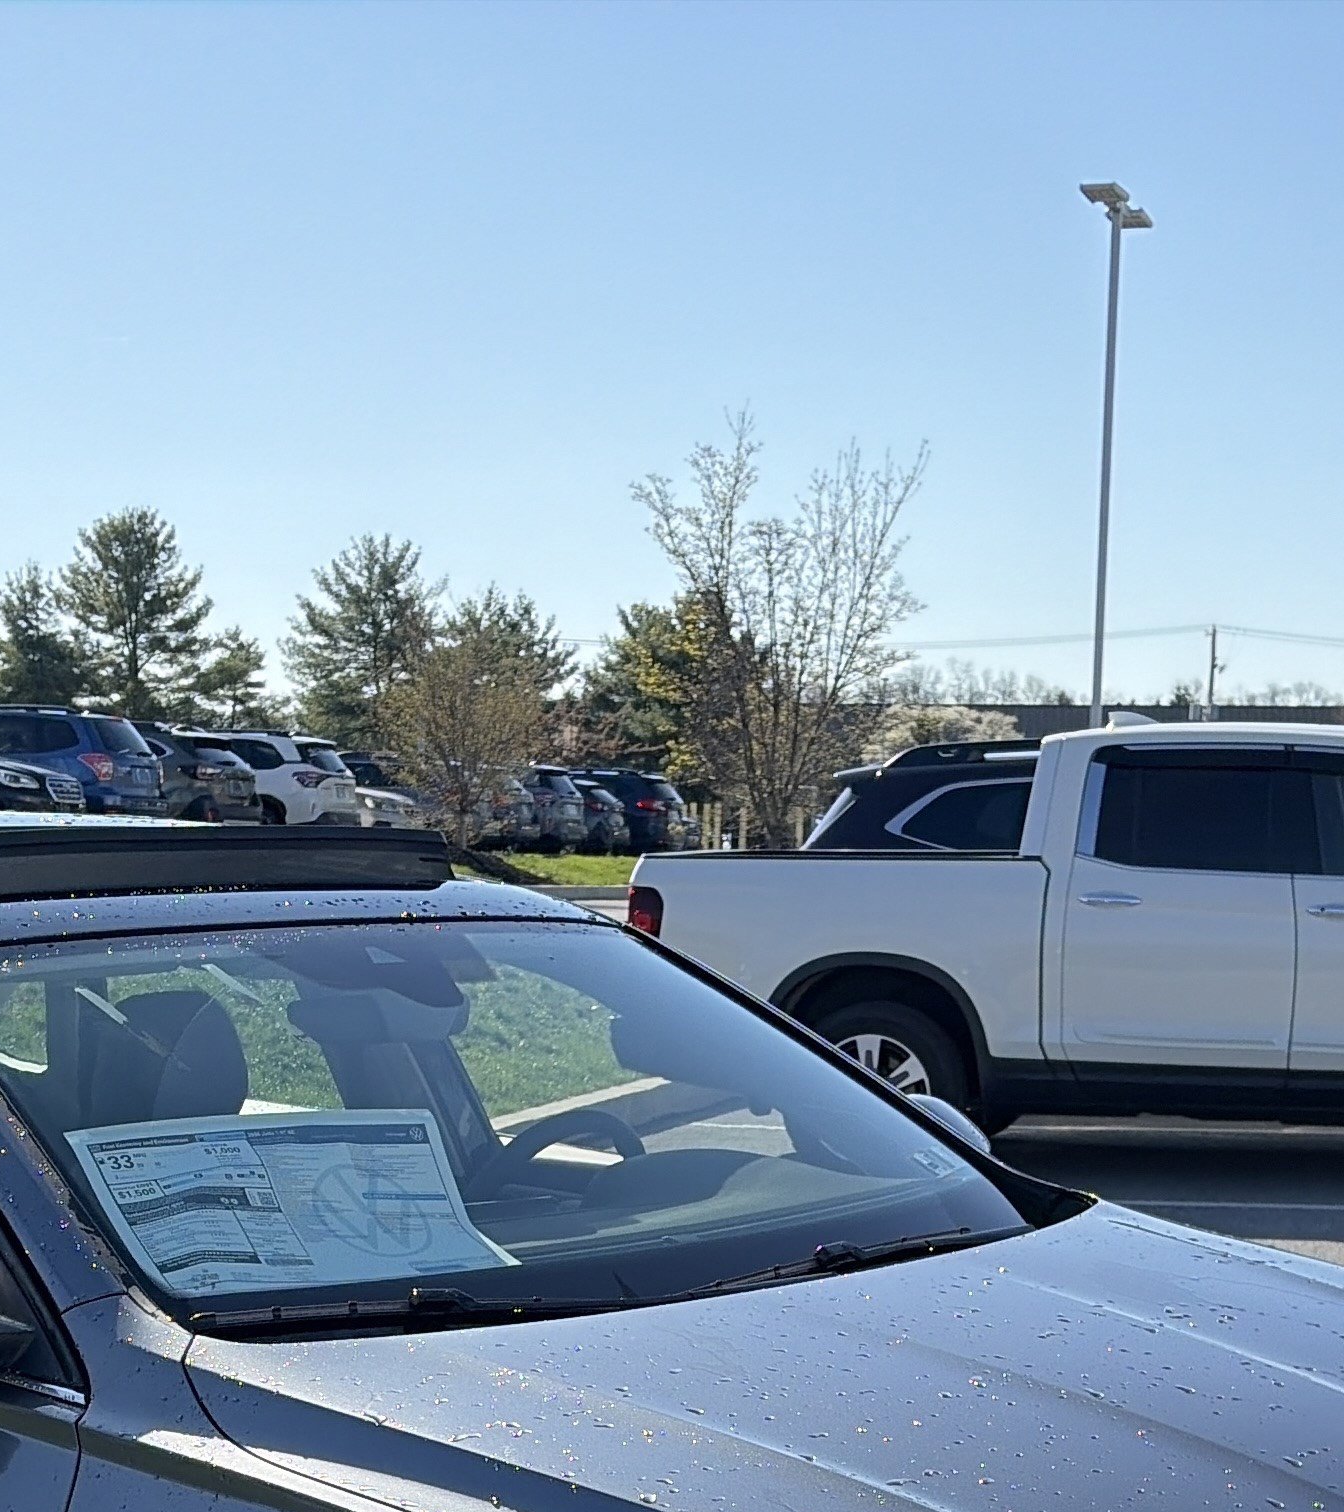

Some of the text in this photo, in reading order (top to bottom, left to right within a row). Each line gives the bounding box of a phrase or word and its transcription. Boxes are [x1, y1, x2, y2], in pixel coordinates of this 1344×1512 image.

[204, 1146, 241, 1155] $1,000
[106, 1154, 135, 1170] 33
[117, 1187, 157, 1200] $1,500
